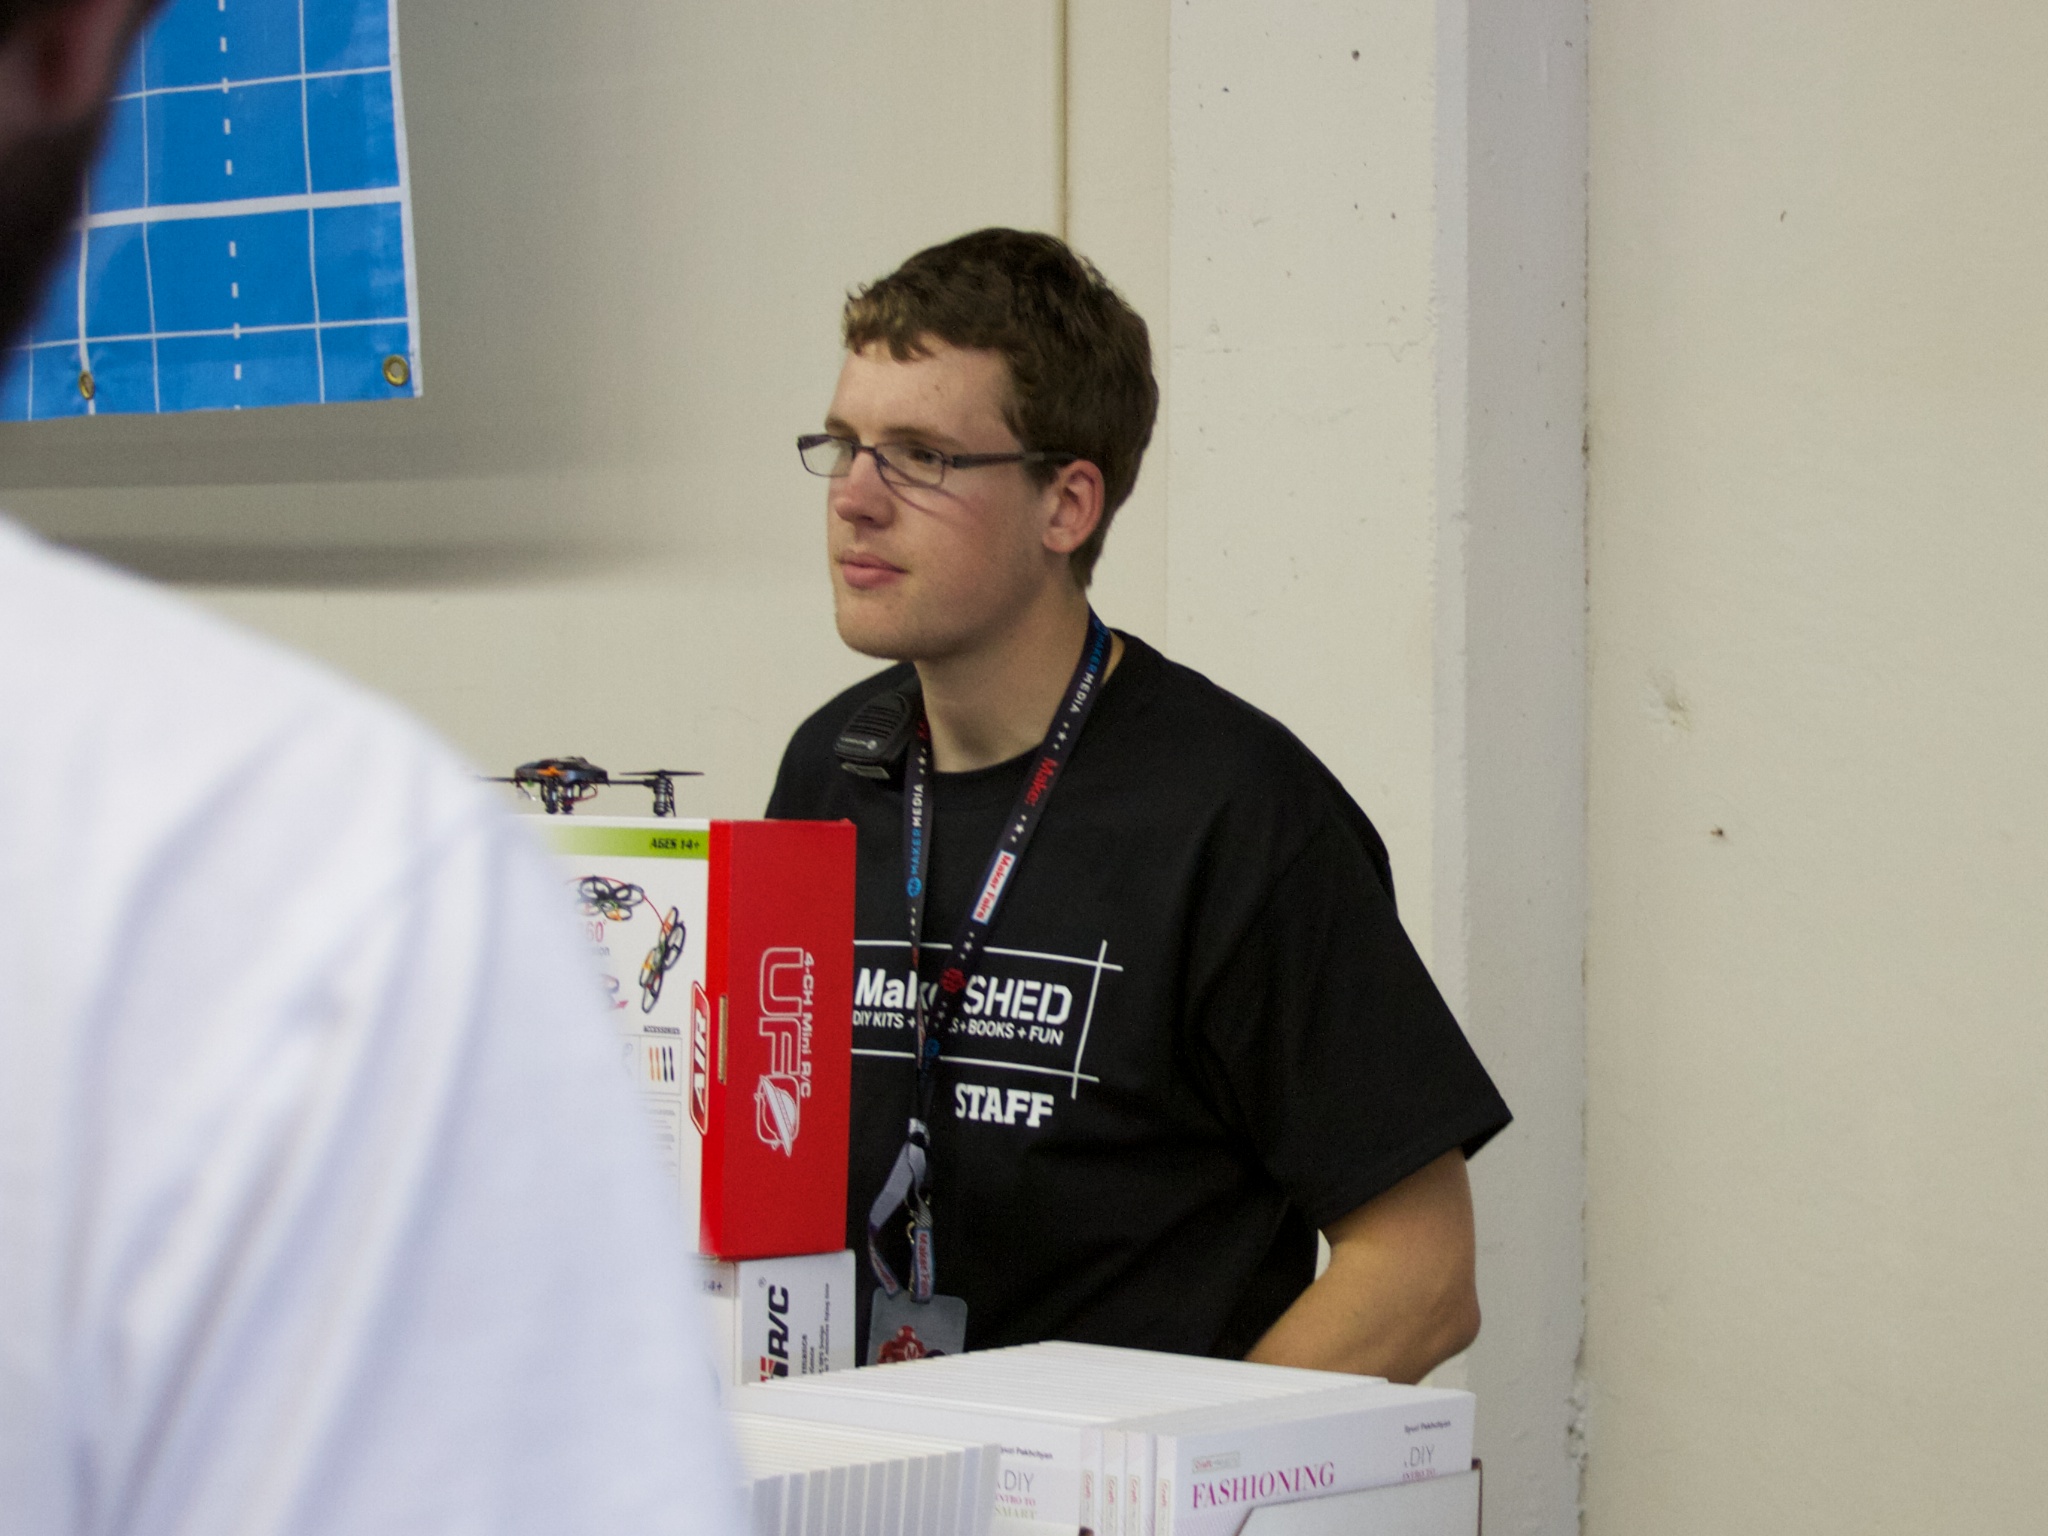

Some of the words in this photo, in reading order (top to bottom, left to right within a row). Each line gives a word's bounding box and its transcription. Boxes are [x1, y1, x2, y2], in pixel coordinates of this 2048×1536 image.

[651, 837, 677, 849] AGES
[681, 839, 699, 850] 14+
[990, 854, 1012, 890] Maker
[975, 891, 996, 919] Faire
[803, 952, 815, 1006] 4-CH
[963, 974, 1073, 1025] SHED
[643, 1024, 680, 1035] ACCESSORIES
[802, 1012, 813, 1055] Mini
[853, 1010, 872, 1026] DIY
[872, 1010, 904, 1029] KITS
[968, 1017, 1015, 1040] BOOKS
[1029, 1025, 1064, 1046] FUN
[694, 1008, 706, 1115] AIR
[754, 946, 804, 1158] UFO
[799, 1061, 812, 1099] R/C
[954, 1081, 1055, 1129] STAFF
[1409, 1443, 1435, 1467] DIY
[1004, 1469, 1035, 1493] DIY
[1193, 1461, 1335, 1509] FASHIONING
